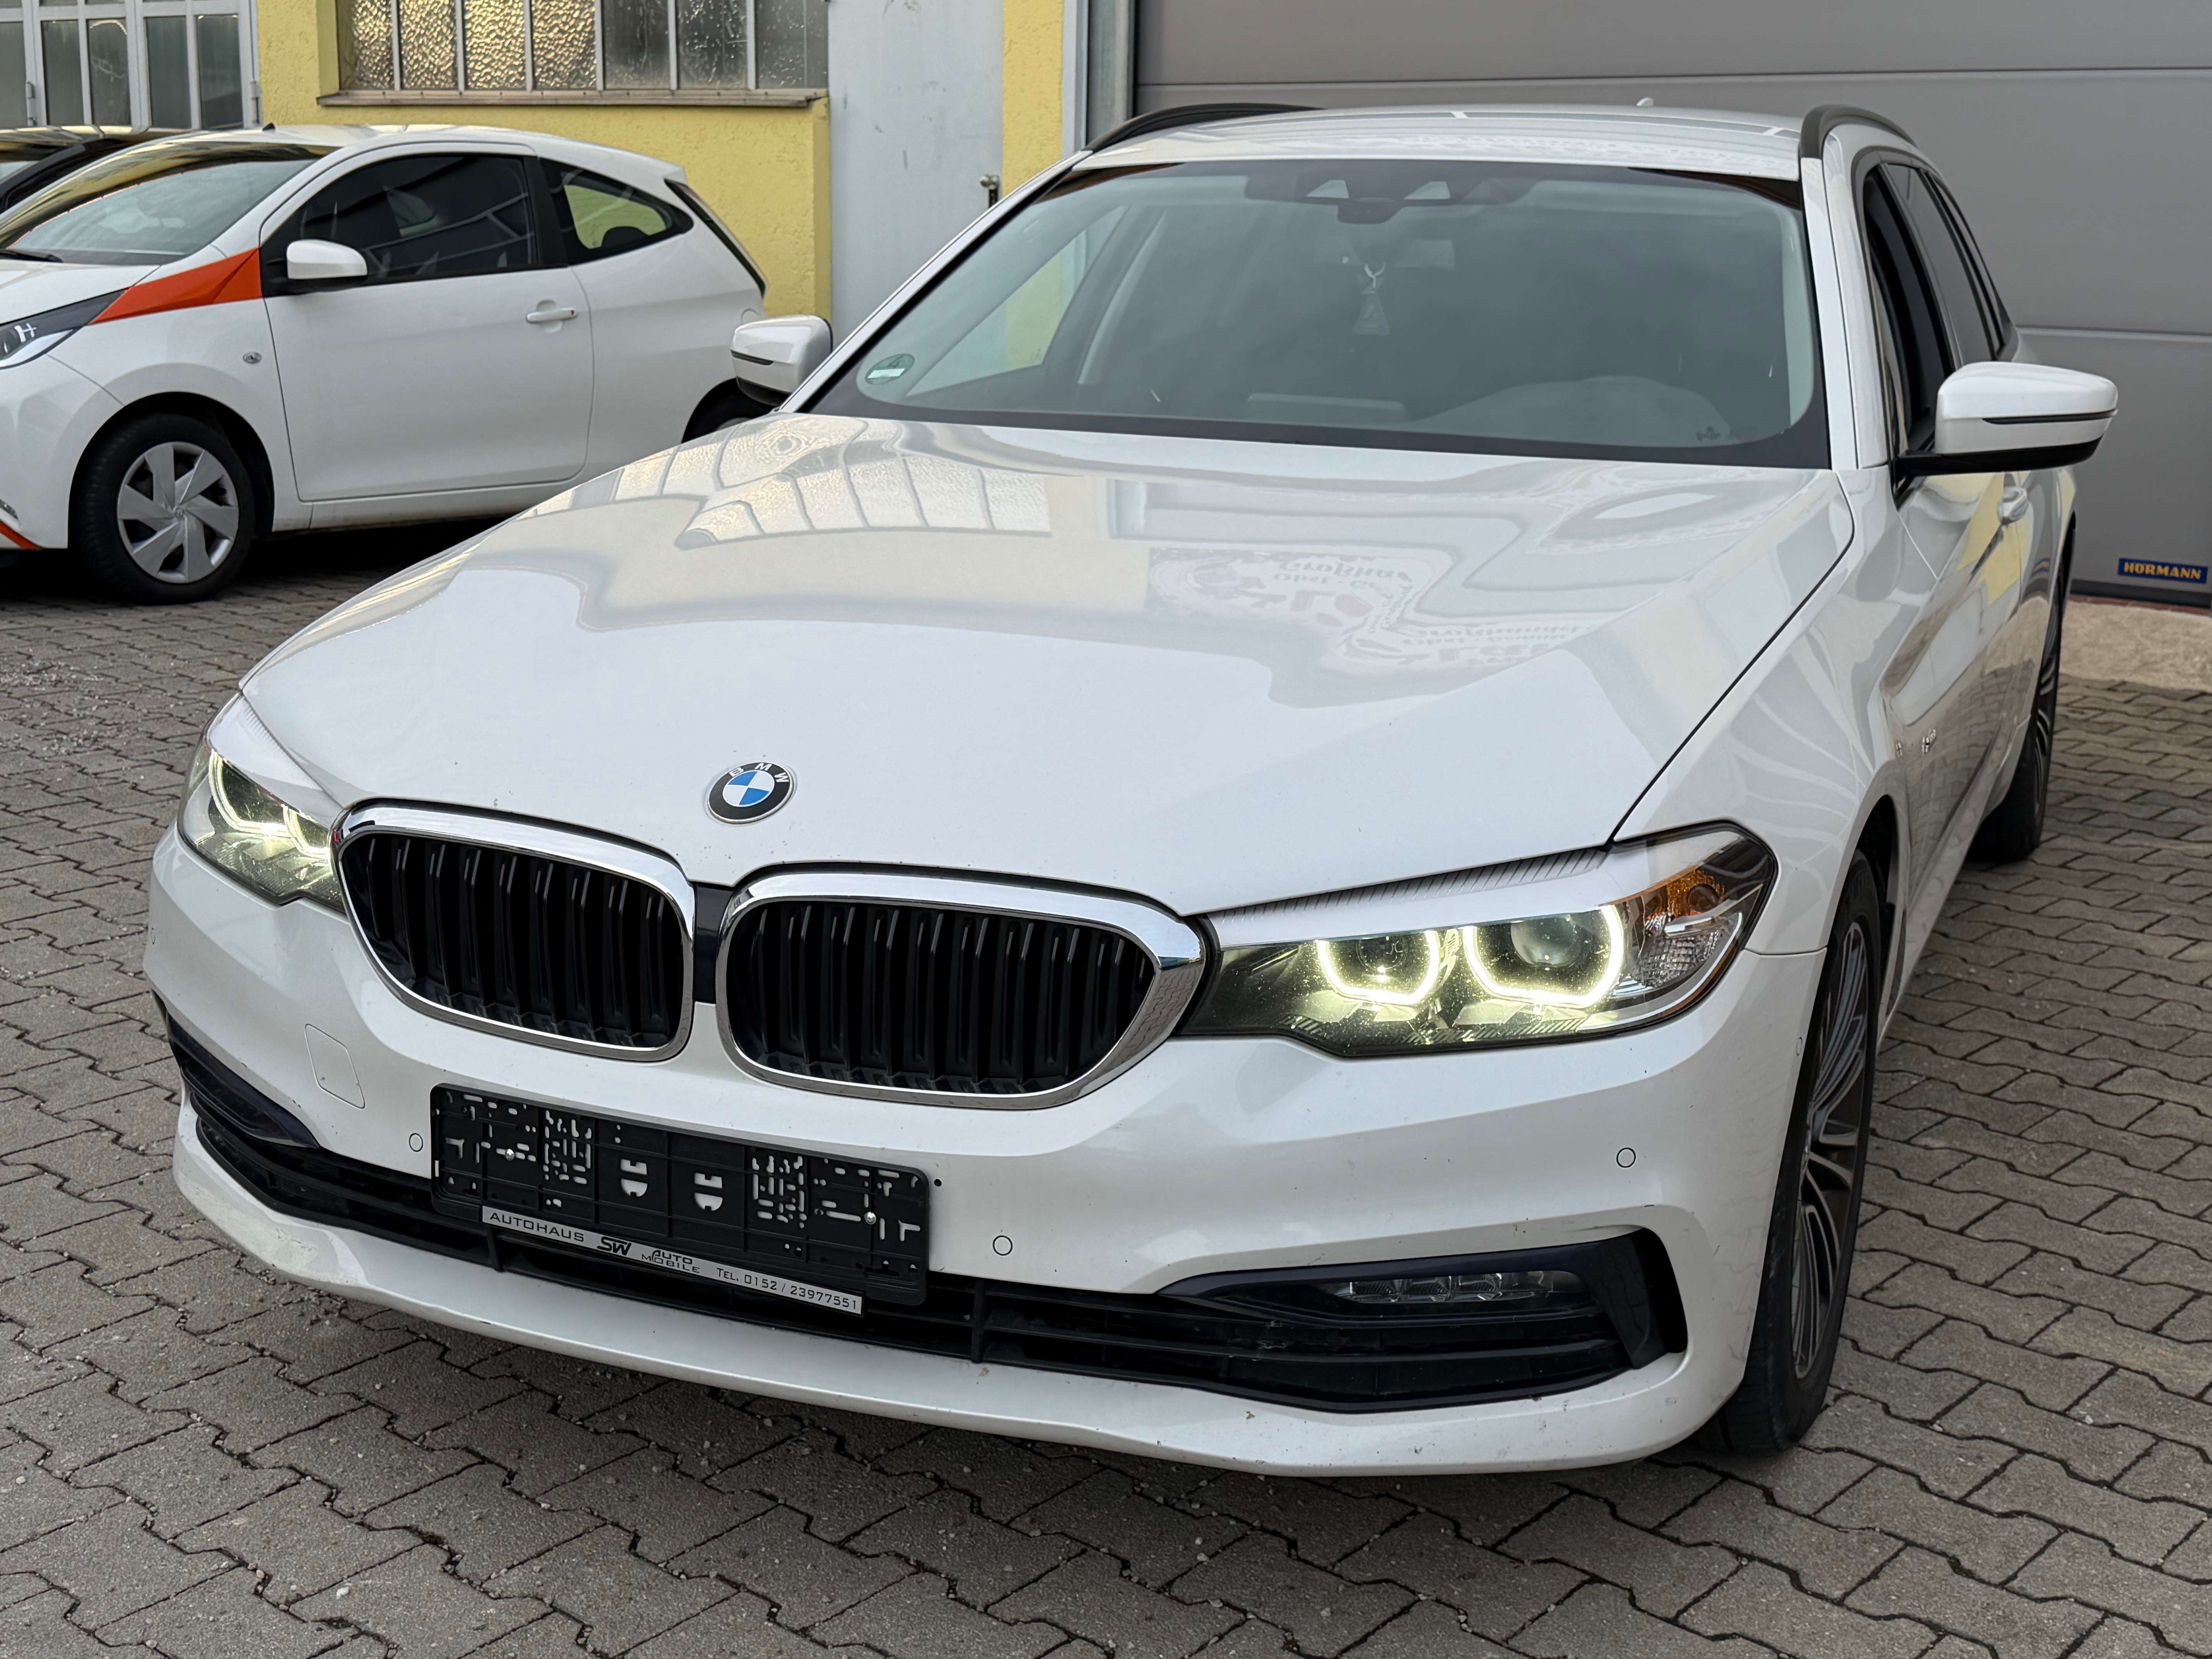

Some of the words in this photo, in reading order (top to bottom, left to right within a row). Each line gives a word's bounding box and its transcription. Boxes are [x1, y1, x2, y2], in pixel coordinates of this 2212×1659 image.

[729, 763, 789, 783] BMW
[490, 1212, 584, 1242] AUTOHAUS
[597, 1236, 632, 1256] SW
[641, 1254, 700, 1273] MOBILE
[651, 1250, 692, 1265] AUTO
[716, 1267, 739, 1281] TEL.
[744, 1274, 777, 1290] 0152
[781, 1283, 786, 1292] /
[790, 1285, 856, 1310] 23977551
